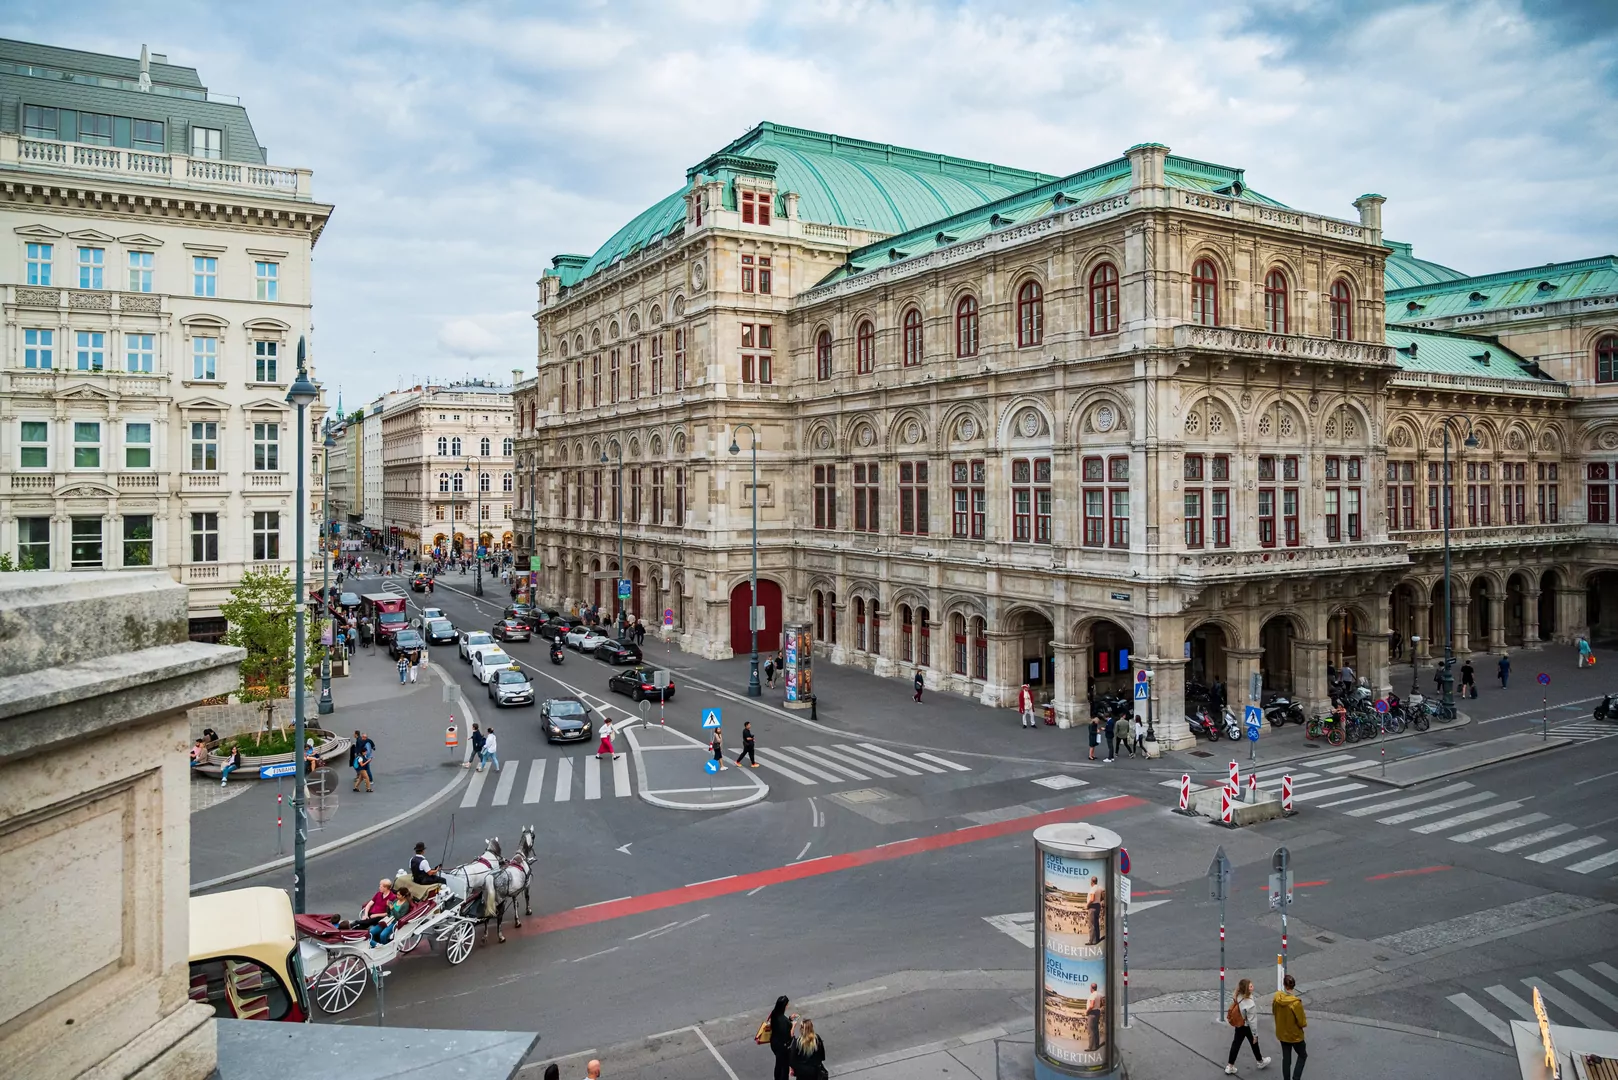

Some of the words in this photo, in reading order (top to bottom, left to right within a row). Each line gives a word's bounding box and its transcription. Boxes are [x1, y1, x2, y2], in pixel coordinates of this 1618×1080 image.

[1047, 854, 1063, 865] JOEL
[1047, 861, 1089, 876] STERNFELD
[1047, 940, 1103, 956] ALBERTINA
[1047, 957, 1063, 970] JOEL
[1047, 964, 1089, 982] STERNFELD
[1047, 1044, 1102, 1063] ALBERTINA
